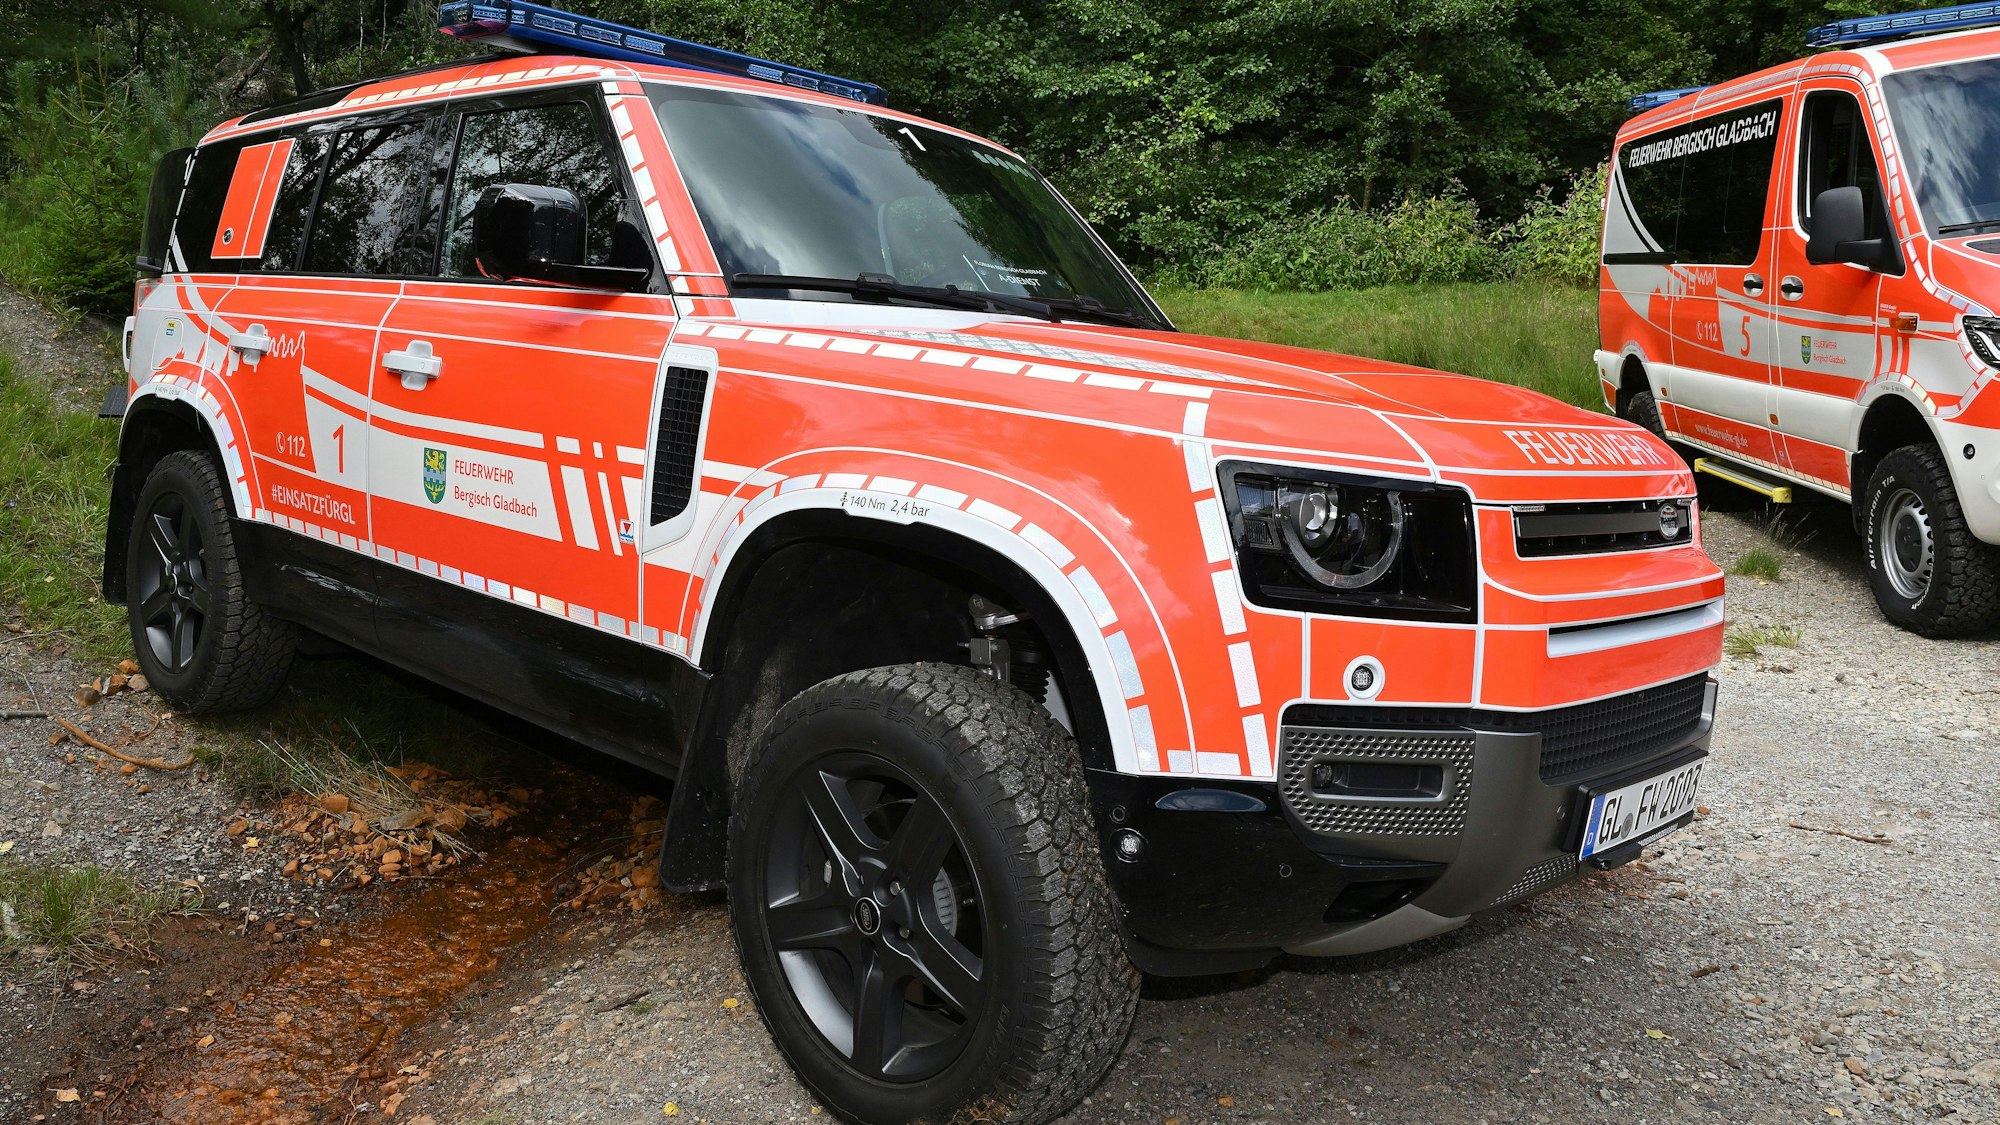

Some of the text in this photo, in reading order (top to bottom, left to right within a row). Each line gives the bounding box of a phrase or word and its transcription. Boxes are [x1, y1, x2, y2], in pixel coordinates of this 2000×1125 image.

[898, 127, 927, 152] 1
[1629, 111, 1777, 168] FEUERWEHR BERGISCH GLADBACH
[998, 273, 1041, 287] A-DIENST
[1020, 268, 1048, 276] GLADBACH
[1703, 321, 1718, 342] 112
[1740, 315, 1751, 357] 5
[1813, 340, 1838, 350] FEUERWEHR
[1813, 353, 1847, 365] Bergisch Gladbach
[287, 434, 306, 458] 112
[332, 424, 344, 474] 1
[1502, 430, 1668, 466] FEUERWEHR
[1695, 424, 1748, 449] www.feuerwehr-gl.de
[454, 459, 514, 485] FEUERWEHR
[271, 484, 356, 525] #EINSATZFÜRGL
[454, 485, 537, 518] Bergisch Gladbach
[850, 496, 931, 517] 140 Nm 2,4 bar
[1599, 795, 1623, 845] GL
[1634, 780, 1664, 831] FW
[1659, 763, 1703, 820] 2093
[1586, 832, 1594, 846] D
